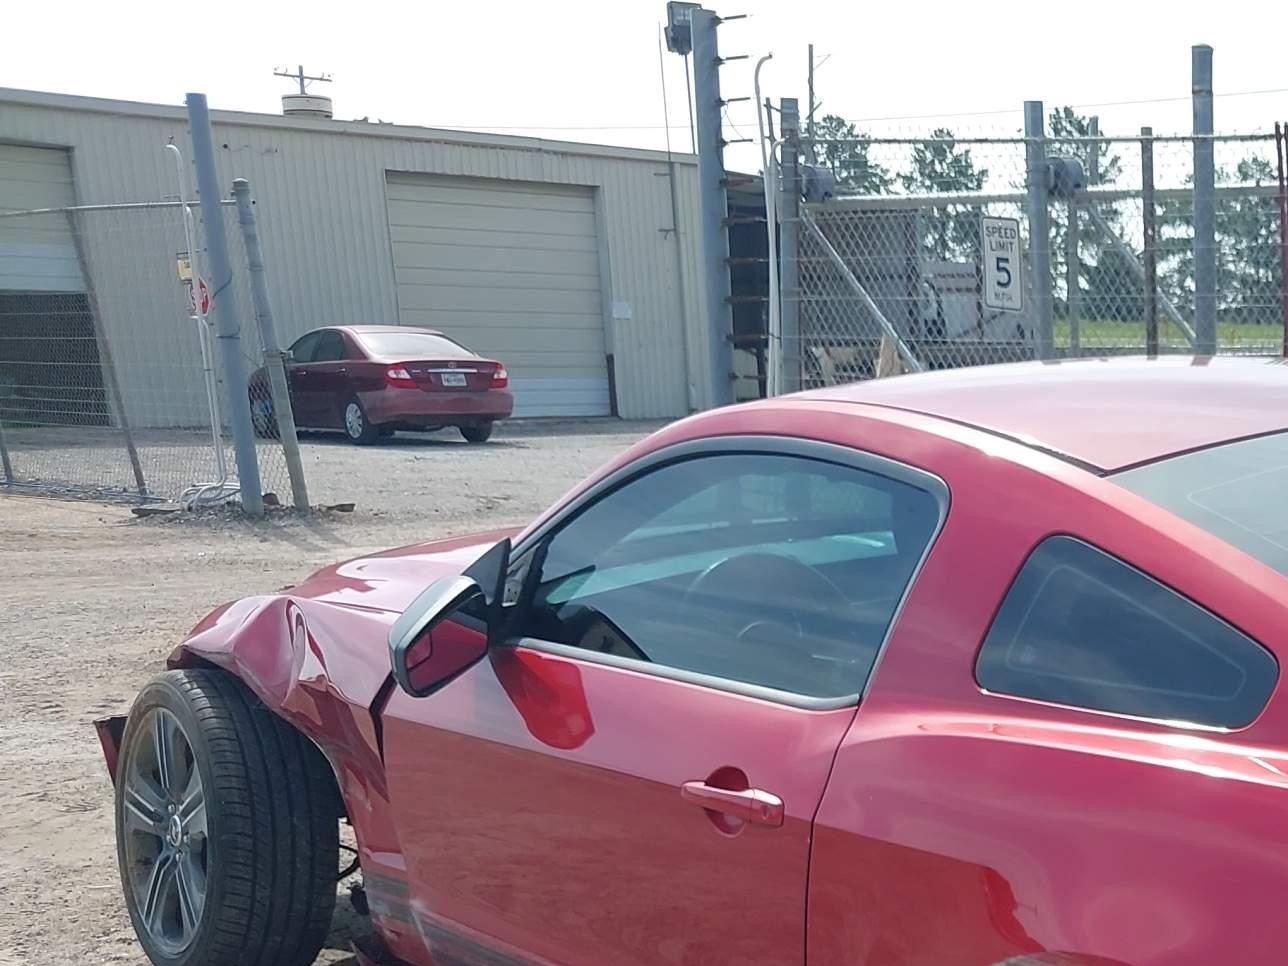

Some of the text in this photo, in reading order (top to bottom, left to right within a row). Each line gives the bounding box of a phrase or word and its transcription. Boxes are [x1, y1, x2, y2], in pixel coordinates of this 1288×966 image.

[986, 225, 1017, 240] SPEED
[989, 240, 1015, 253] LIMIT
[996, 256, 1011, 288] 5
